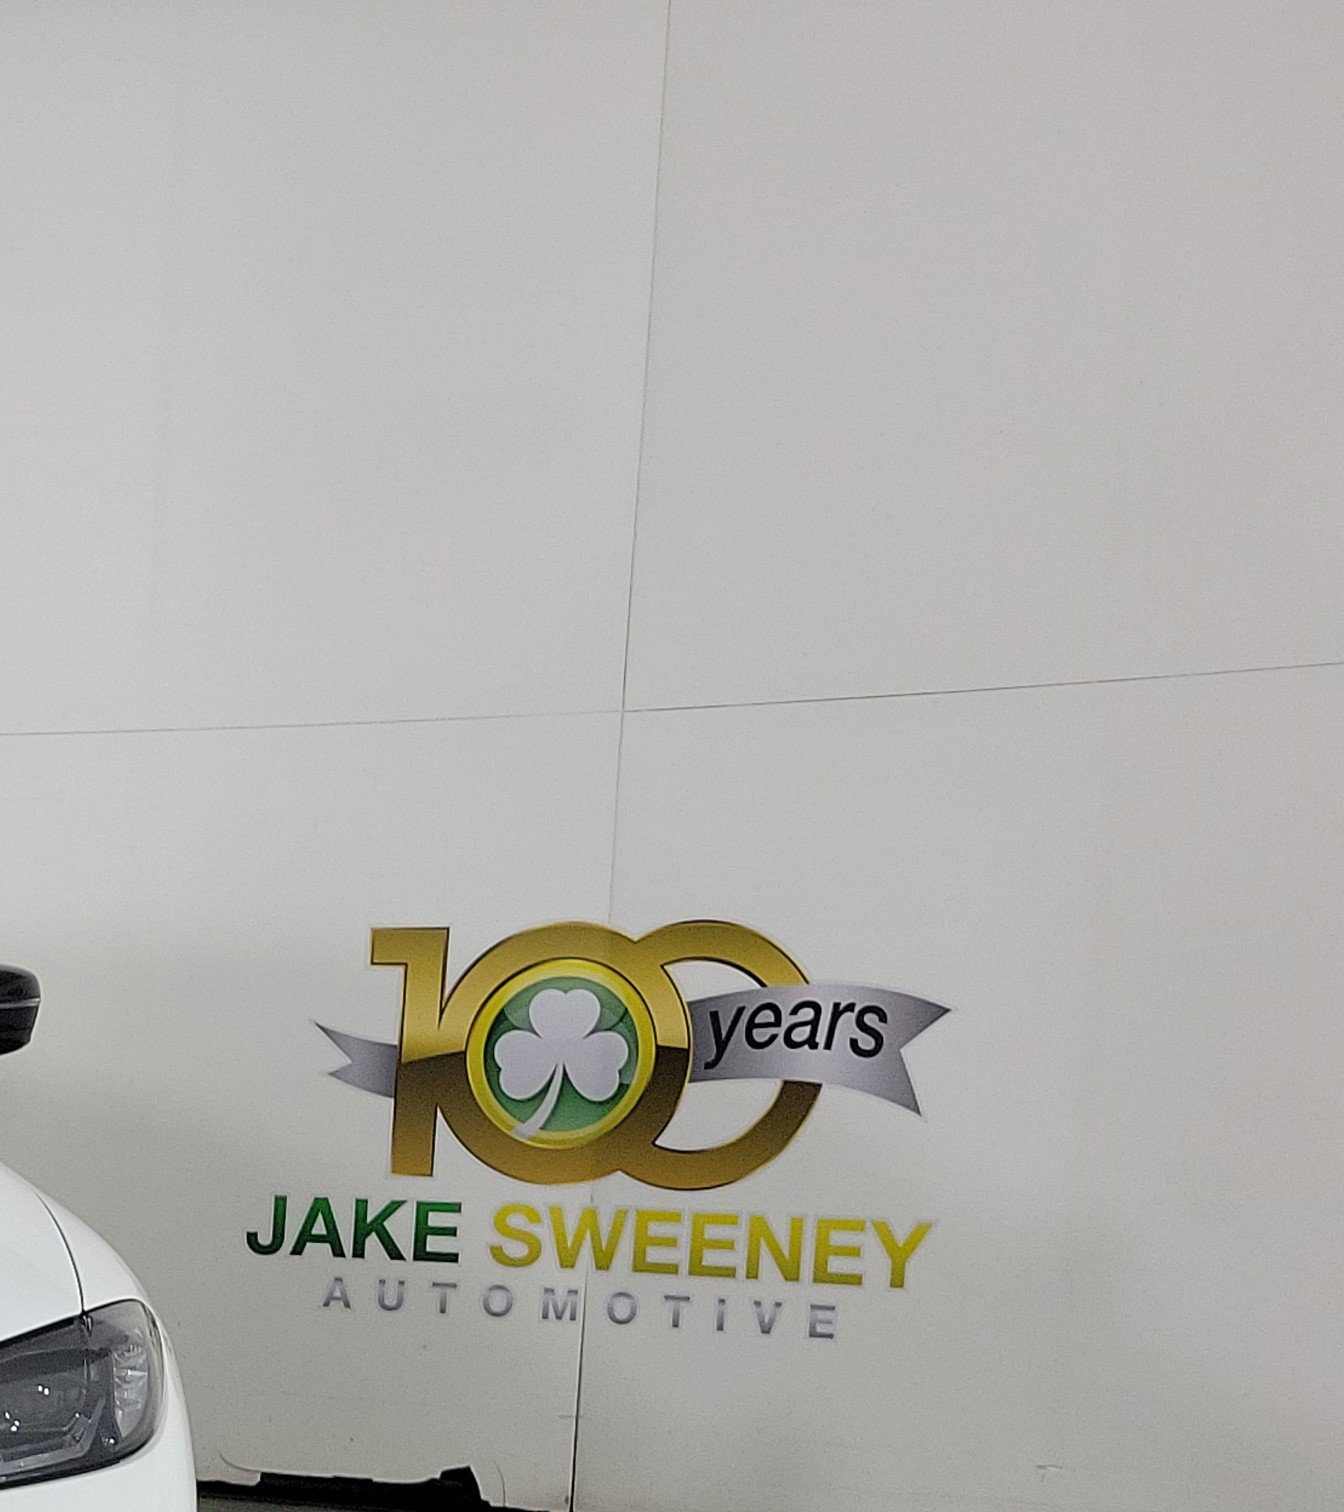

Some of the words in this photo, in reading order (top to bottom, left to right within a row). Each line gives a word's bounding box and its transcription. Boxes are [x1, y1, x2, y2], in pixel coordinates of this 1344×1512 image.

[370, 919, 823, 1191] 100
[703, 998, 888, 1070] years
[246, 1194, 463, 1264] JAKE
[488, 1204, 933, 1289] SWEENEY
[322, 1276, 836, 1341] AUTOMOTIVE
